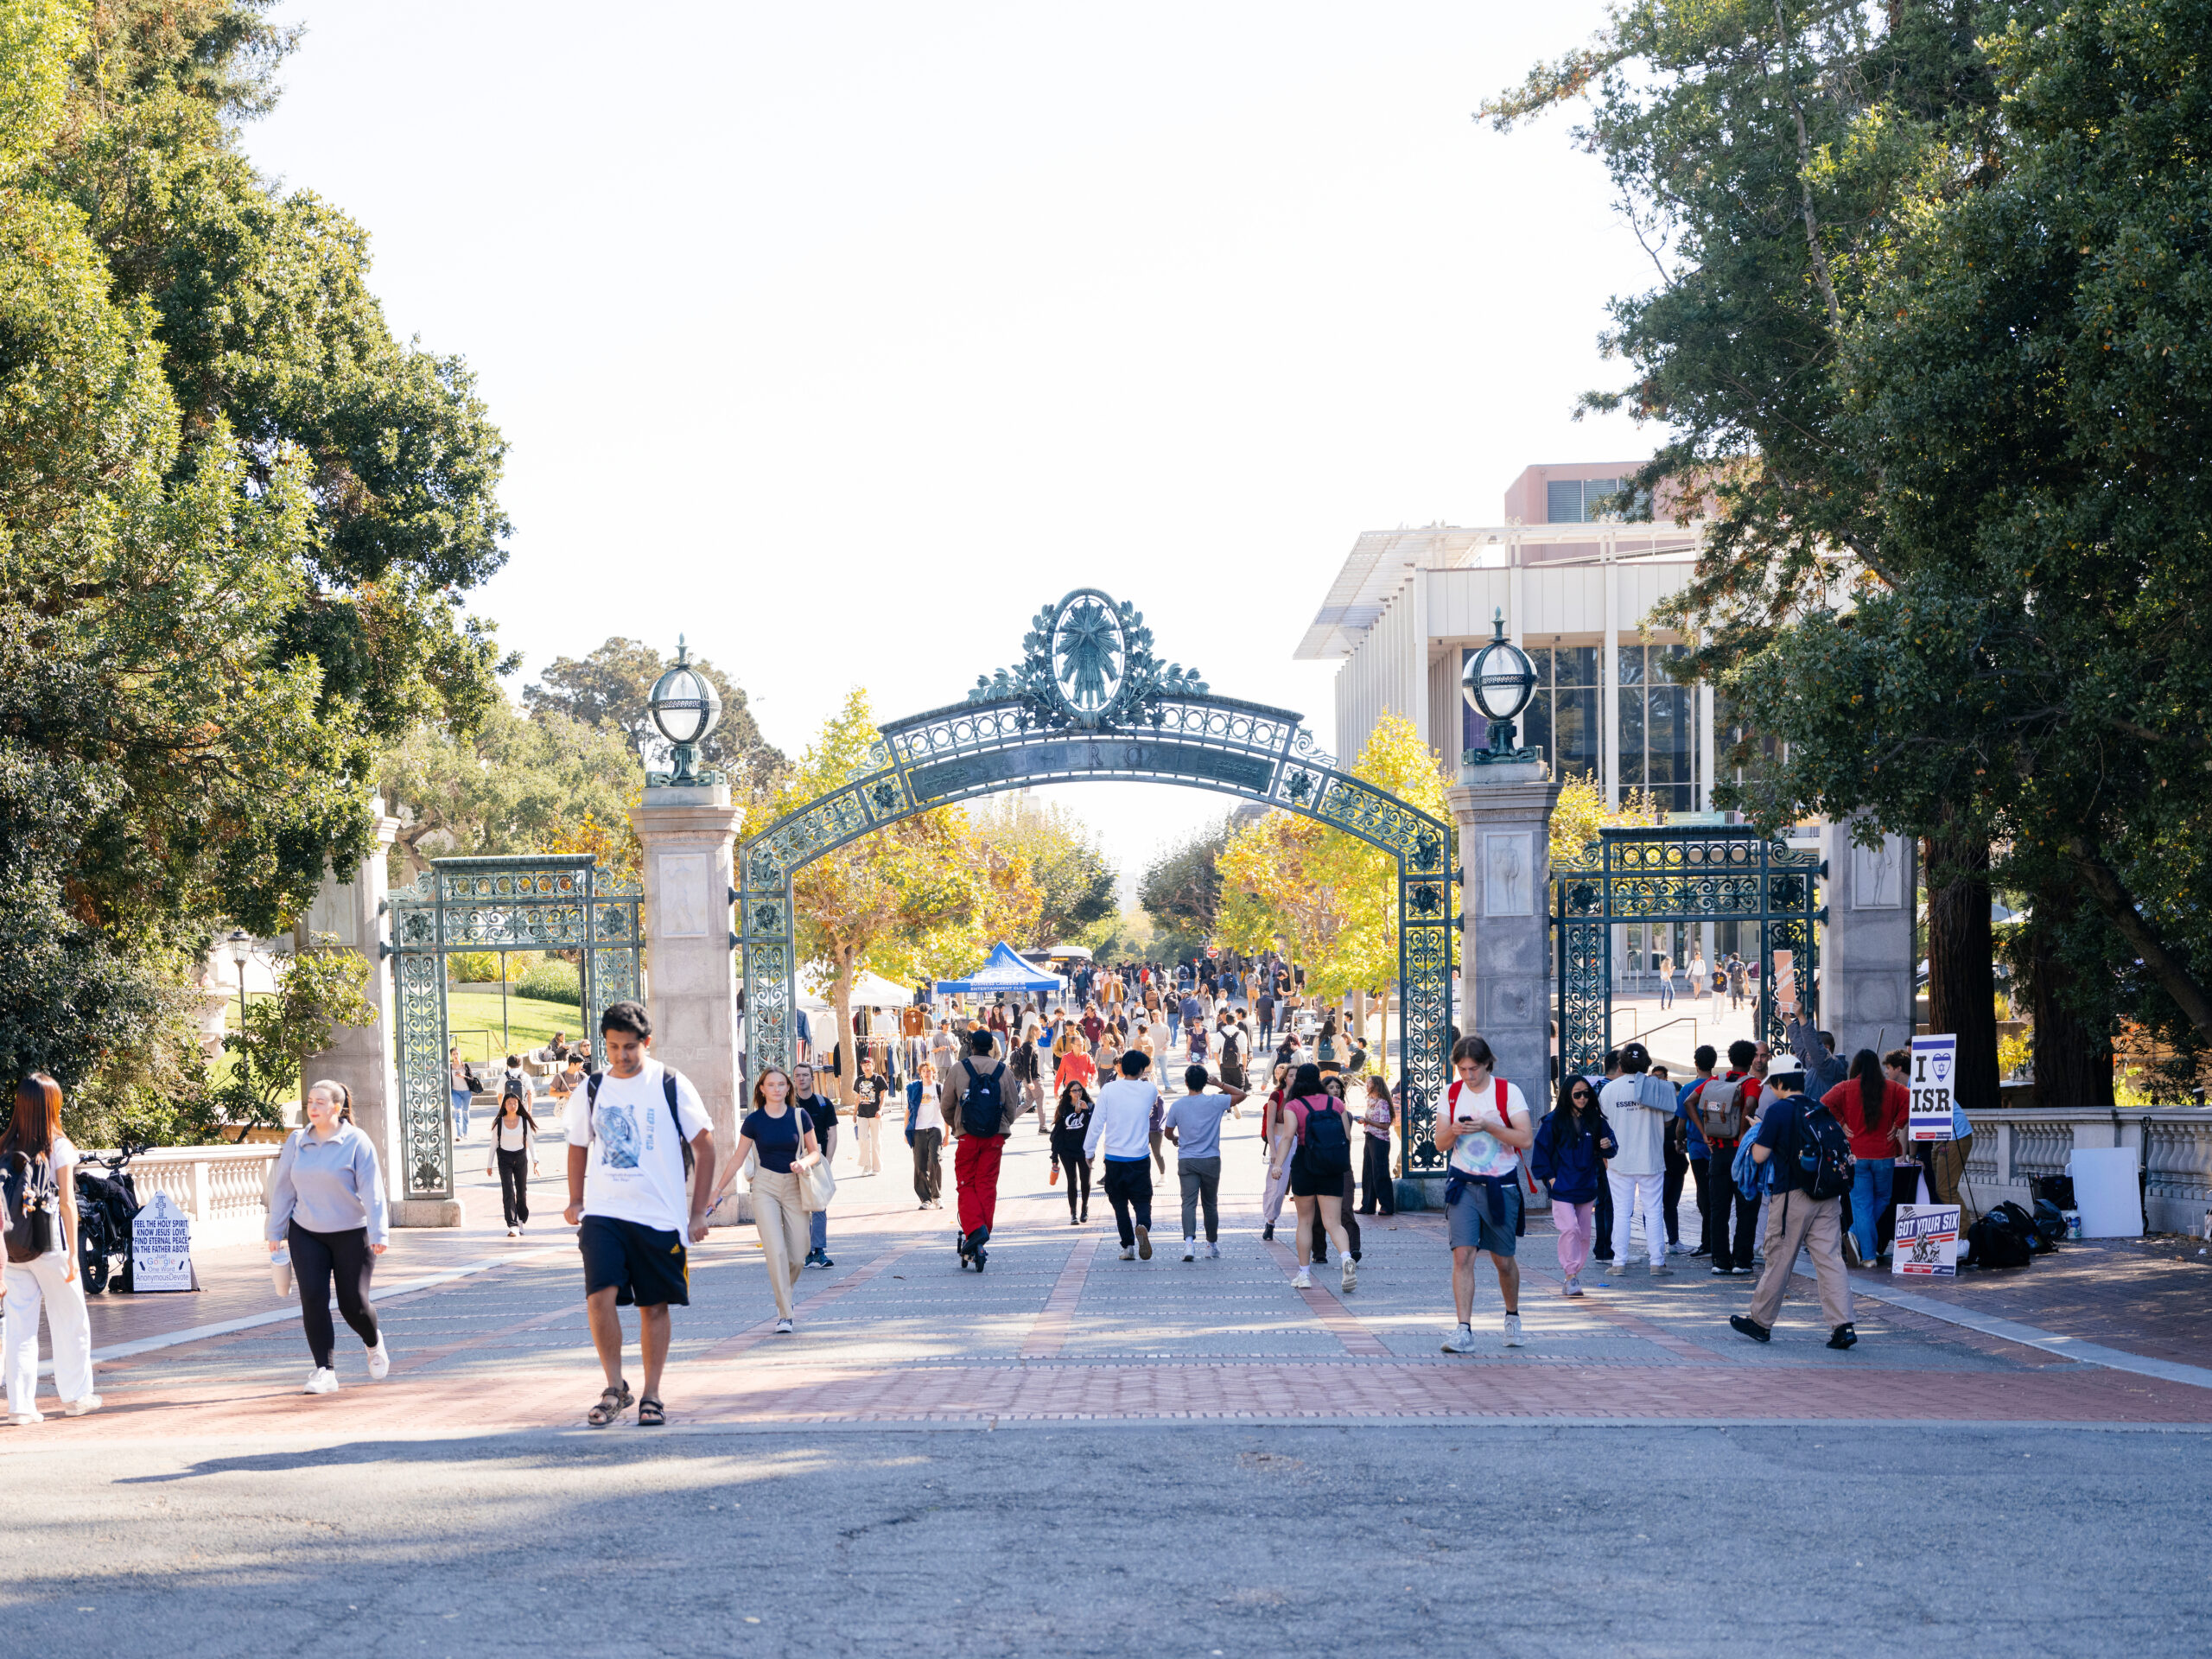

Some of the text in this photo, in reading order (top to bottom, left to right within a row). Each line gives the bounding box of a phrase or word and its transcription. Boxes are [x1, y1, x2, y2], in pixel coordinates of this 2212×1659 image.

[976, 745, 1206, 779] SATHER GATE
[1915, 1055, 1927, 1083] I
[1911, 1088, 1951, 1113] ISR
[646, 1108, 655, 1124] KEEP
[1065, 1112, 1085, 1129] Cal
[645, 1134, 654, 1150] WILD
[1897, 1212, 1959, 1237] GOT YOUR SIX
[147, 1257, 175, 1267] Google
[136, 1273, 189, 1283] AnonymousDevote
